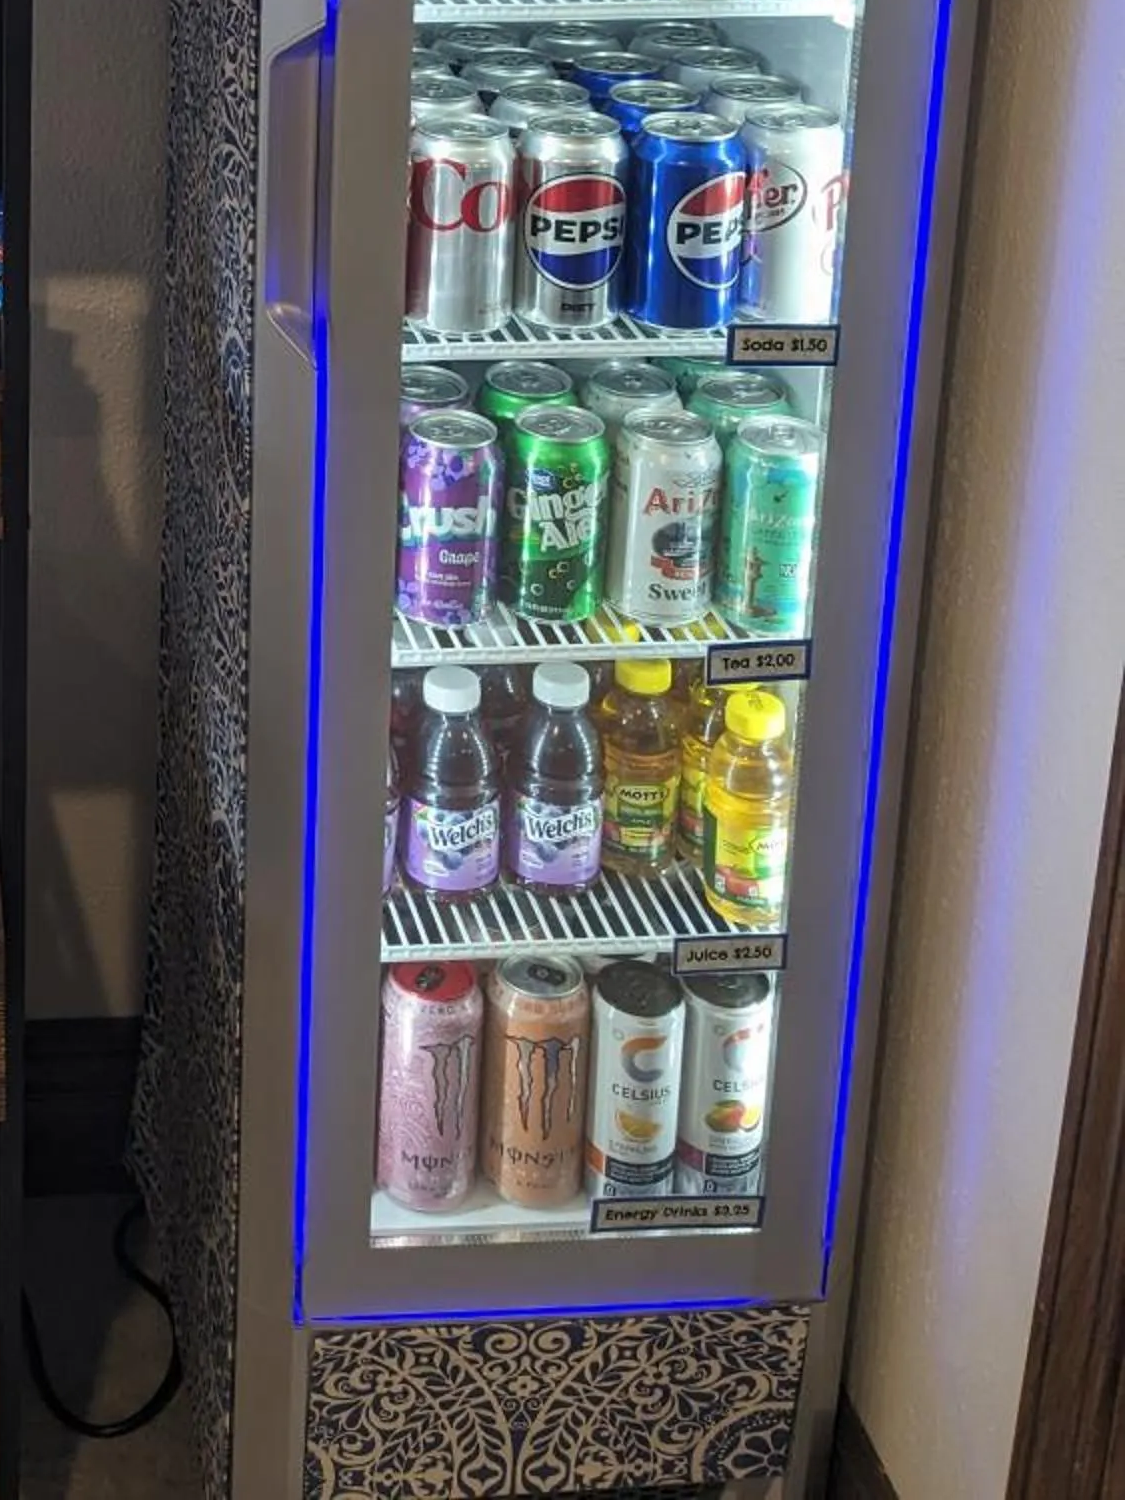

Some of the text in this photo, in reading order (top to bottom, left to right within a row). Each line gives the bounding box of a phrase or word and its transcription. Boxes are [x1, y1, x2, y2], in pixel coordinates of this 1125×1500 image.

[560, 302, 595, 312] DIET
[742, 337, 828, 353] Soda $1.50
[402, 495, 497, 540] rush
[721, 652, 796, 671] Tea $2.00
[431, 812, 493, 848] Welch's
[527, 810, 592, 840] Welch's
[685, 945, 773, 964] Juice $2.50
[611, 1082, 672, 1102] CELSIUS
[605, 1207, 659, 1222] Energy
[662, 1205, 708, 1218] Drinks
